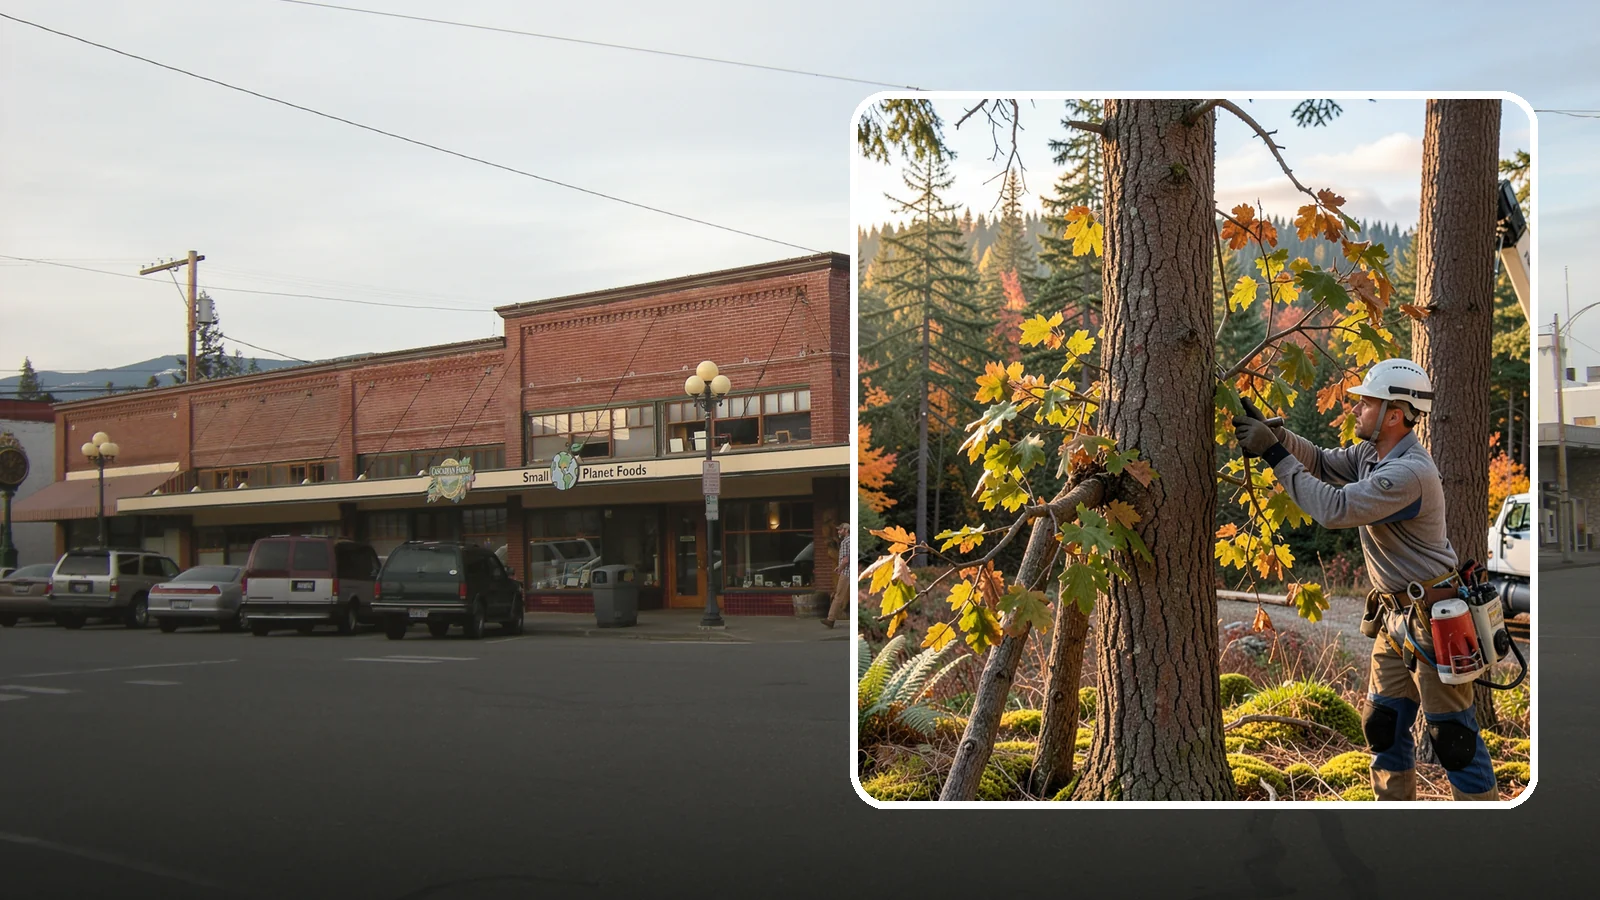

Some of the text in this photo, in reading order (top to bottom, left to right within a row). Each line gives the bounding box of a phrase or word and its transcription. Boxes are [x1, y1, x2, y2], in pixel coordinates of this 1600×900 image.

[431, 466, 469, 476] CASCADIAN FARM
[523, 464, 647, 483] Small Planet Foods
